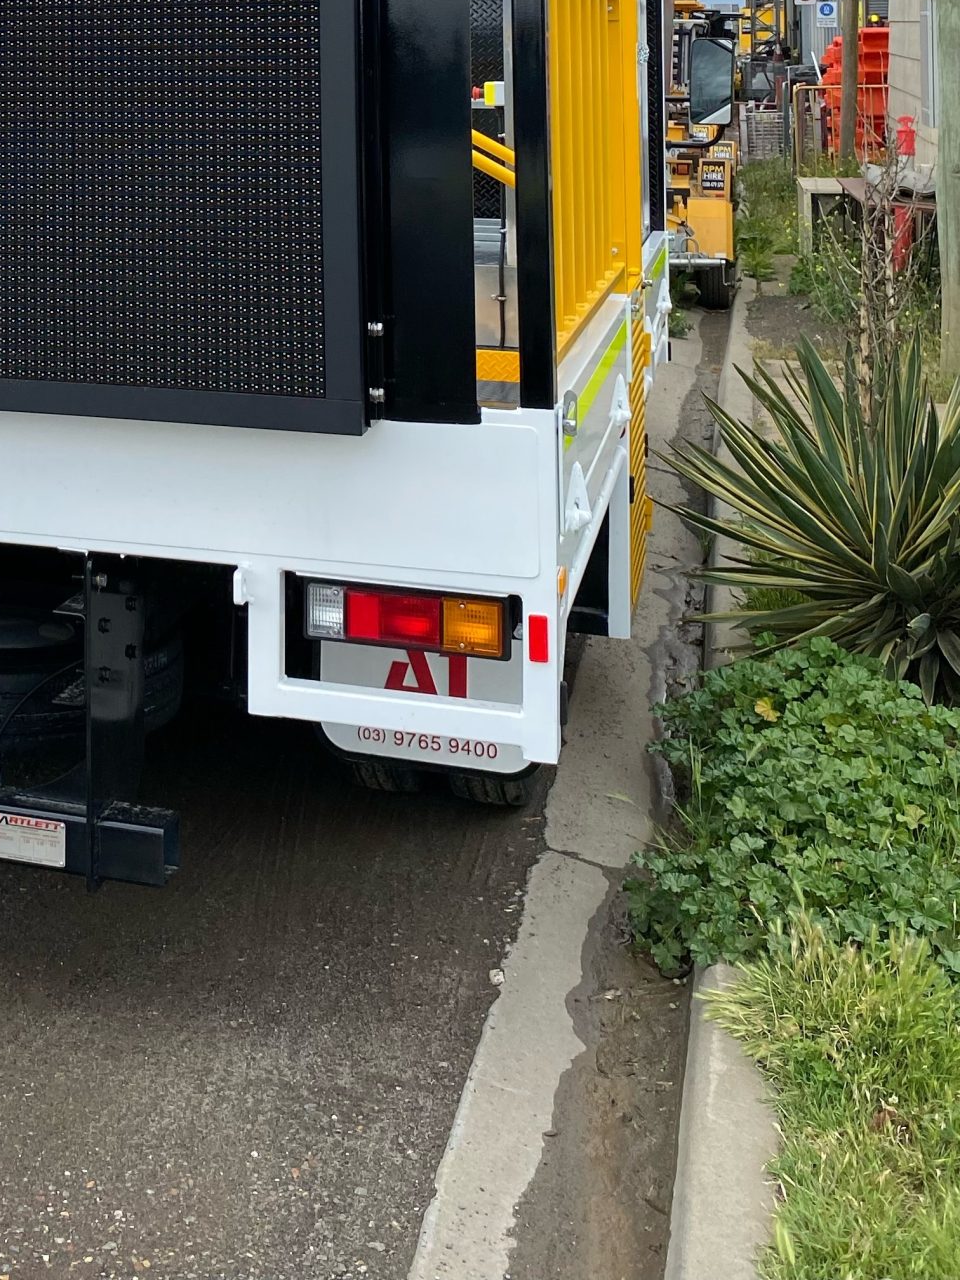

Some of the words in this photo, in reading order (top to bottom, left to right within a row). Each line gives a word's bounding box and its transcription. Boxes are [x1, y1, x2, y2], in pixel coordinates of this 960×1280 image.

[703, 165, 724, 173] RPM
[357, 726, 386, 744] (03)
[393, 731, 442, 751] 9765
[448, 738, 498, 759] 9400
